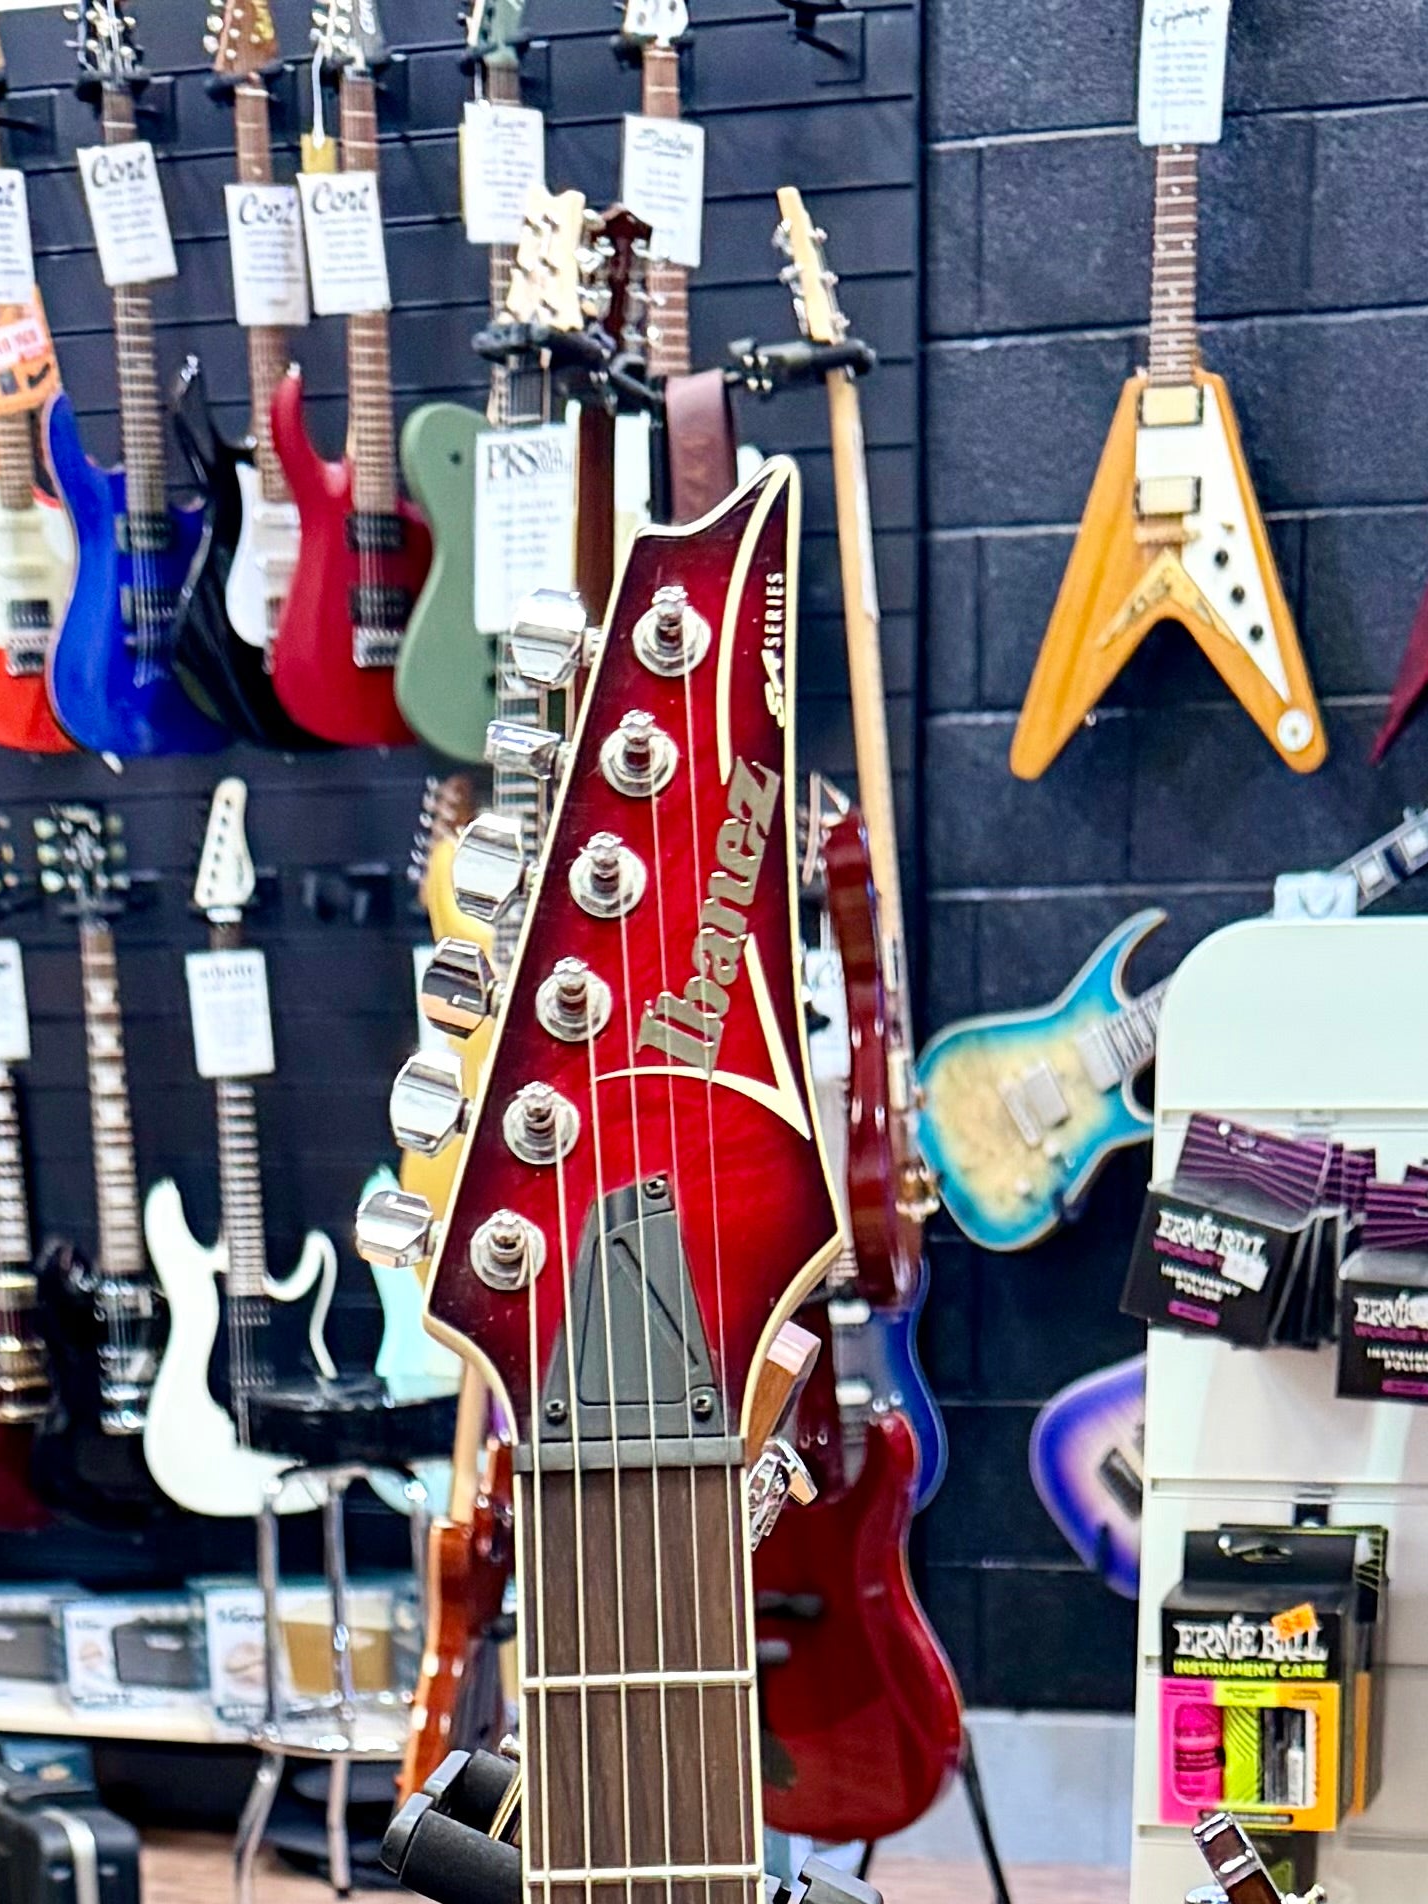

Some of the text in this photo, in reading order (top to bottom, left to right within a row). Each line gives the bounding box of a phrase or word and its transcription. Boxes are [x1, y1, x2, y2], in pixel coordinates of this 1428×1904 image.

[91, 154, 147, 188] Cort
[239, 192, 295, 226] Cort
[311, 181, 370, 215] Cort
[763, 572, 786, 647] SERIES
[636, 755, 781, 1078] Ibanez
[1155, 1210, 1221, 1253] ERNIE
[1173, 1612, 1259, 1660] ERNIE
[1173, 1658, 1328, 1679] INSTRUMENT CARE
